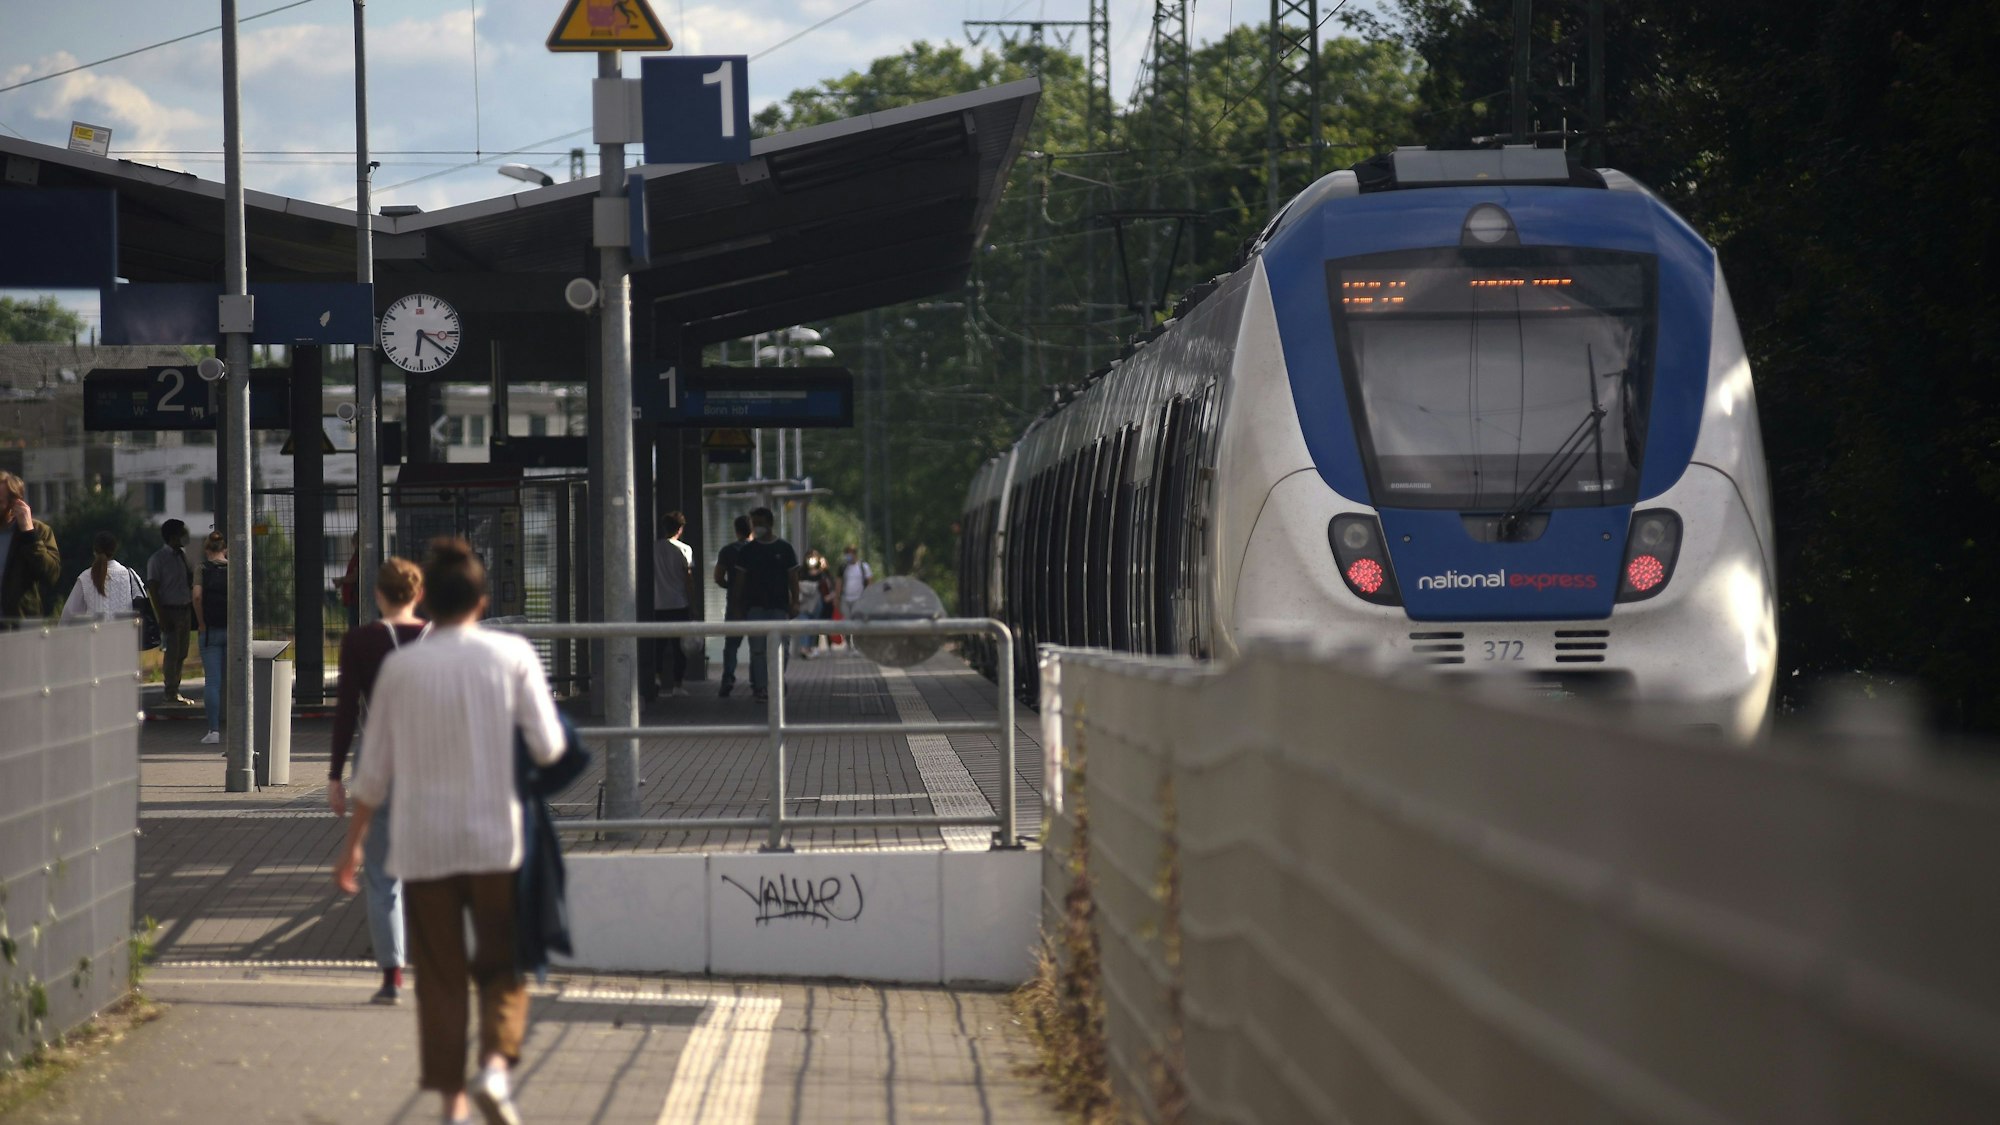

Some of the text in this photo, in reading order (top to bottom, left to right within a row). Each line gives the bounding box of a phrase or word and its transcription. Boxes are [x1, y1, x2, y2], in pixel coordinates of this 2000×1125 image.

[703, 61, 735, 137] 1
[156, 368, 185, 412] 2
[659, 366, 677, 409] 1
[703, 404, 749, 416] Bonn Hbf
[1418, 569, 1598, 592] national express
[1483, 640, 1525, 661] 372
